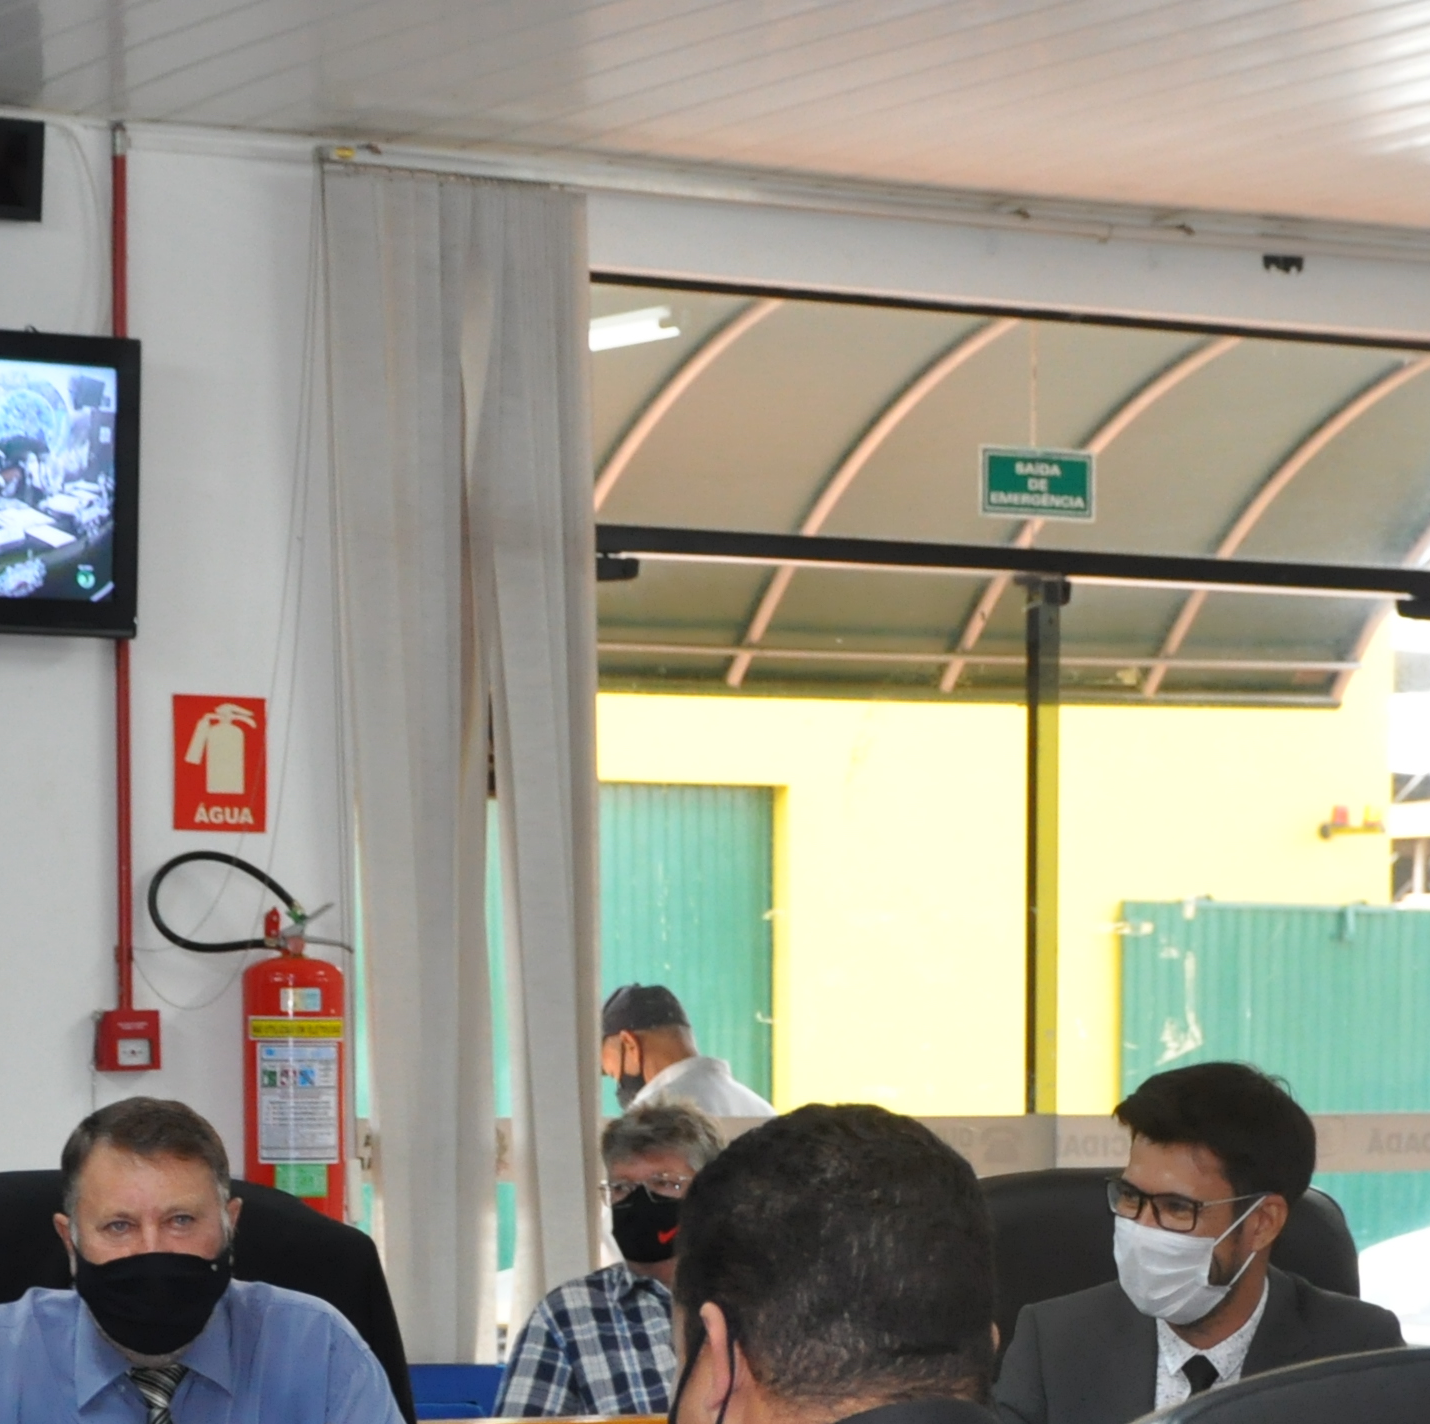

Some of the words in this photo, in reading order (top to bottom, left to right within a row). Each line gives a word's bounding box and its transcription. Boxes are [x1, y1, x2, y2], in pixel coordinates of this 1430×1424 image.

[1015, 461, 1061, 477] SAÍDA
[1027, 478, 1049, 492] DE
[990, 491, 1085, 508] EMERGÊNCIA
[194, 802, 255, 824] ÁGUA
